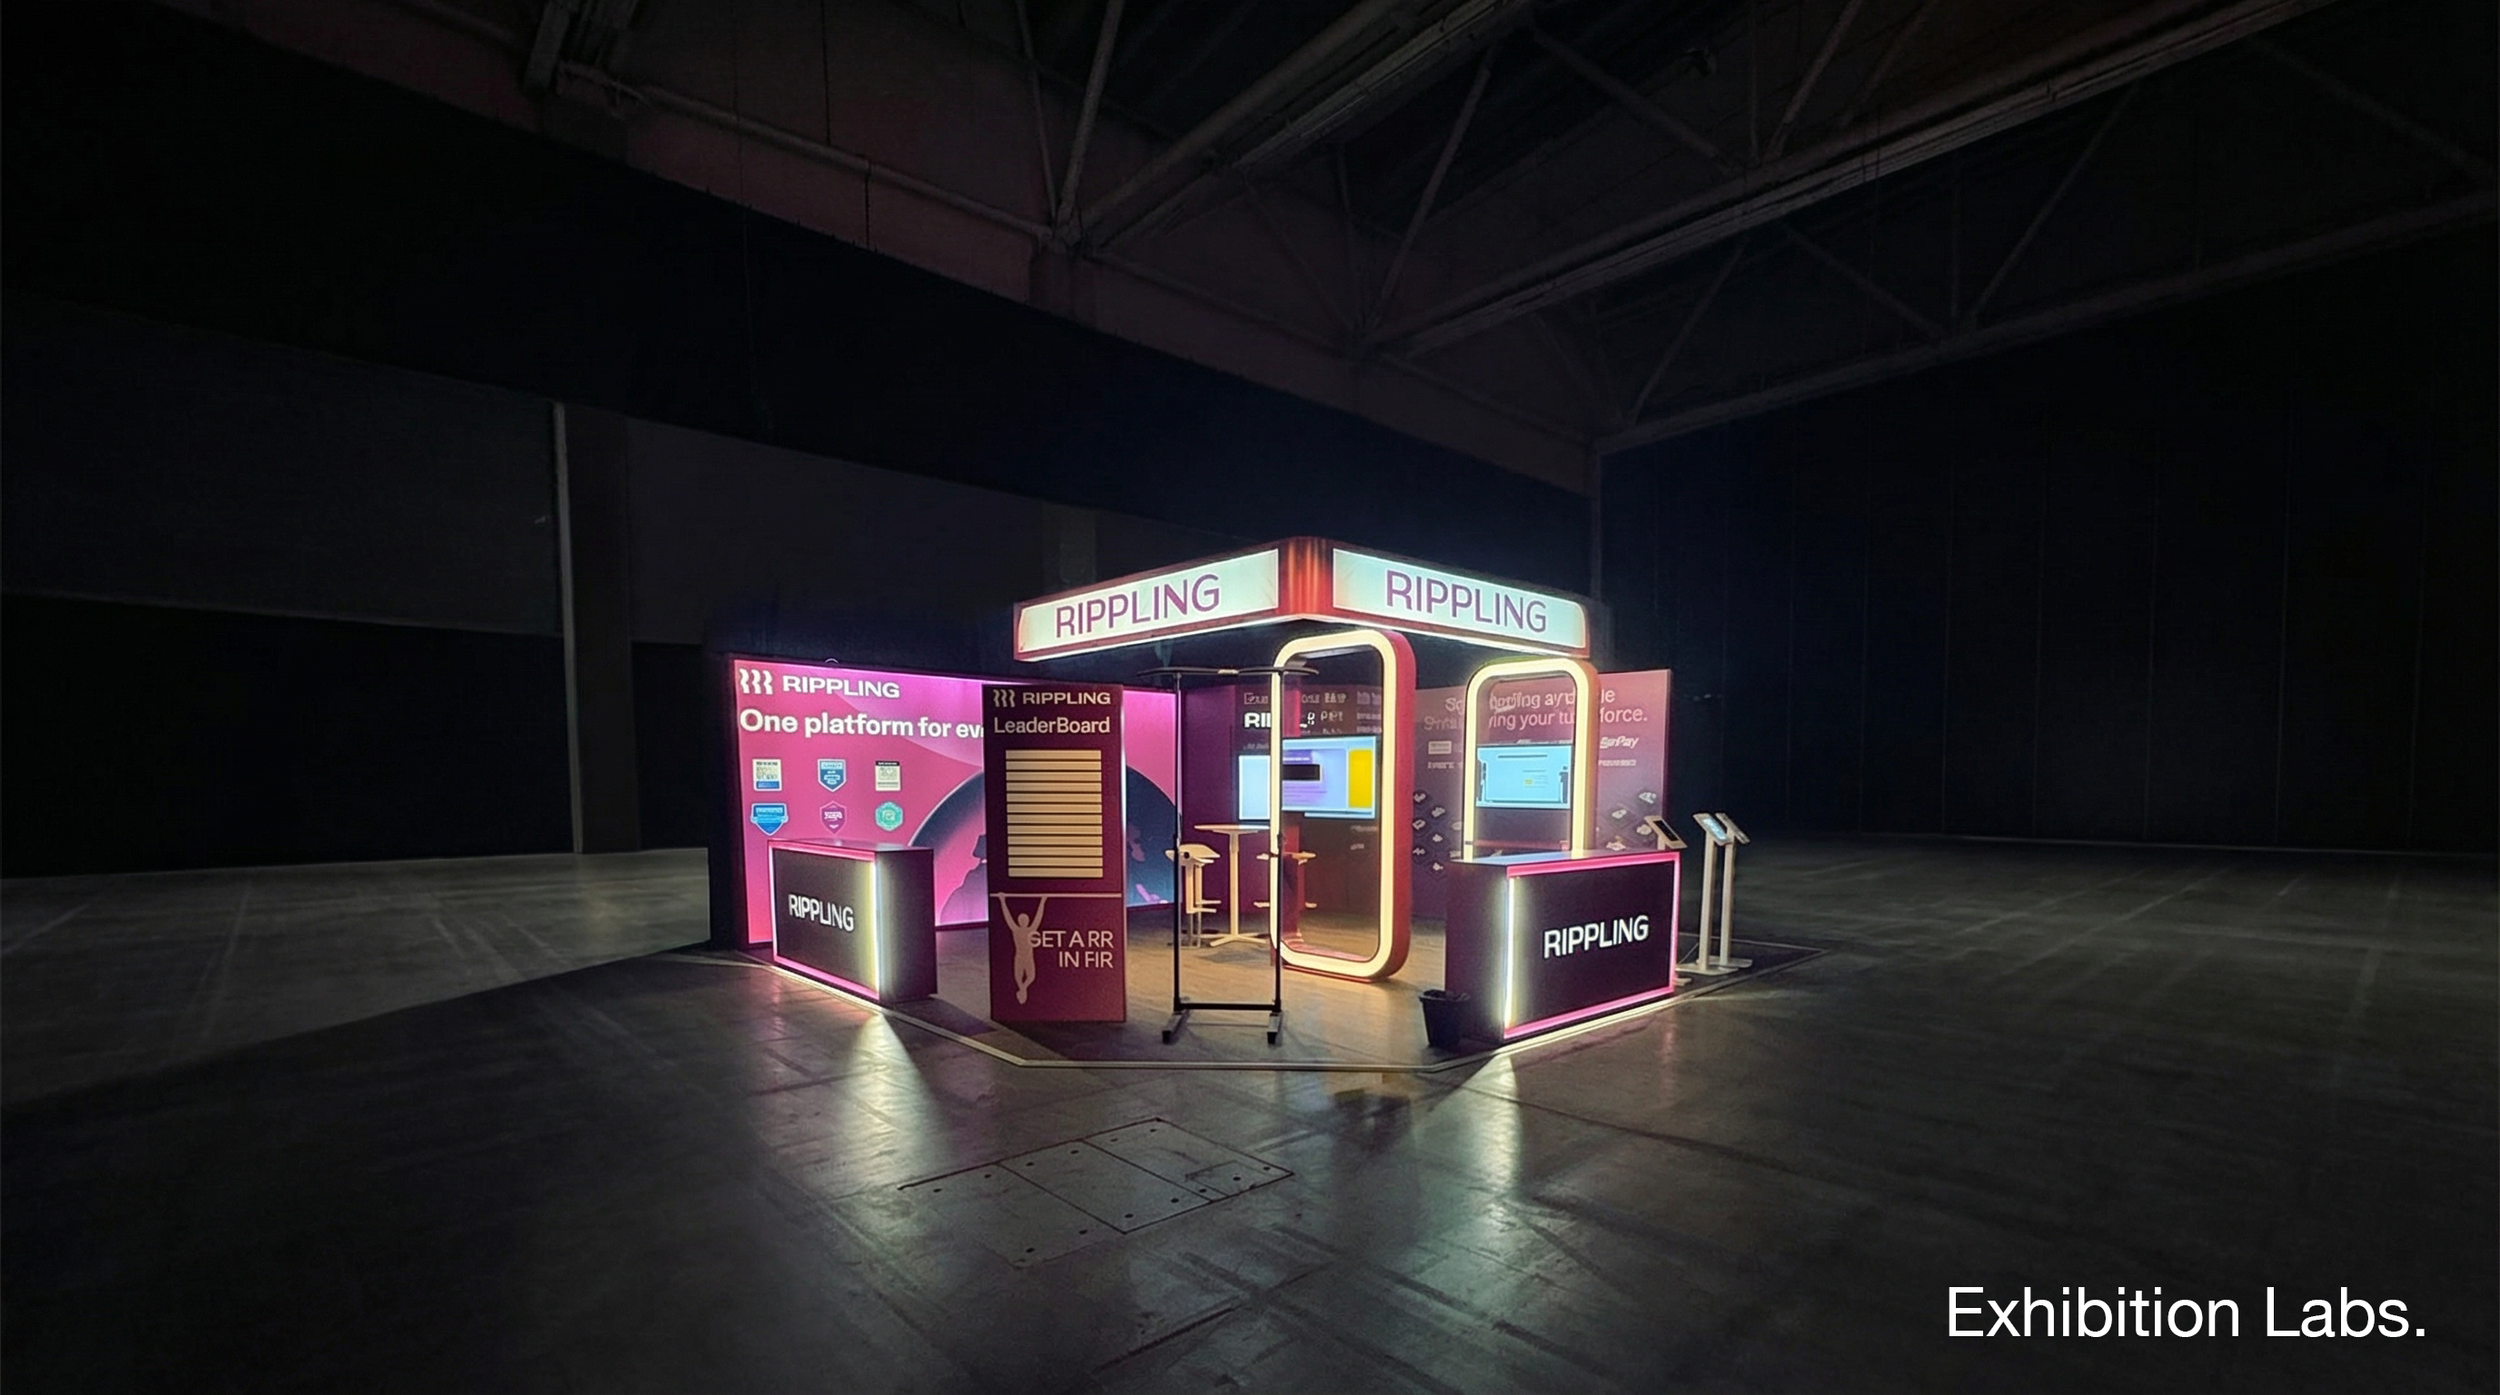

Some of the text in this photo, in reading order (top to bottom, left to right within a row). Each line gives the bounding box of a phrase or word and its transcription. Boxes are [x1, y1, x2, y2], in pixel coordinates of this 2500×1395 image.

[1056, 573, 1220, 638] RIPPLING
[1386, 569, 1548, 633] RIPPLING
[782, 674, 901, 699] RIPPLING
[1022, 691, 1112, 705] RIPPLING
[739, 708, 799, 733] One
[804, 711, 914, 738] platform
[917, 716, 952, 738] for
[993, 716, 1111, 734] LeaderBoard
[1518, 713, 1556, 731] your
[787, 893, 855, 933] RIPPLING
[1068, 930, 1086, 948] A
[1087, 930, 1115, 949] RR
[1543, 914, 1650, 960] RIPPLING
[1058, 950, 1114, 969] IN FIR
